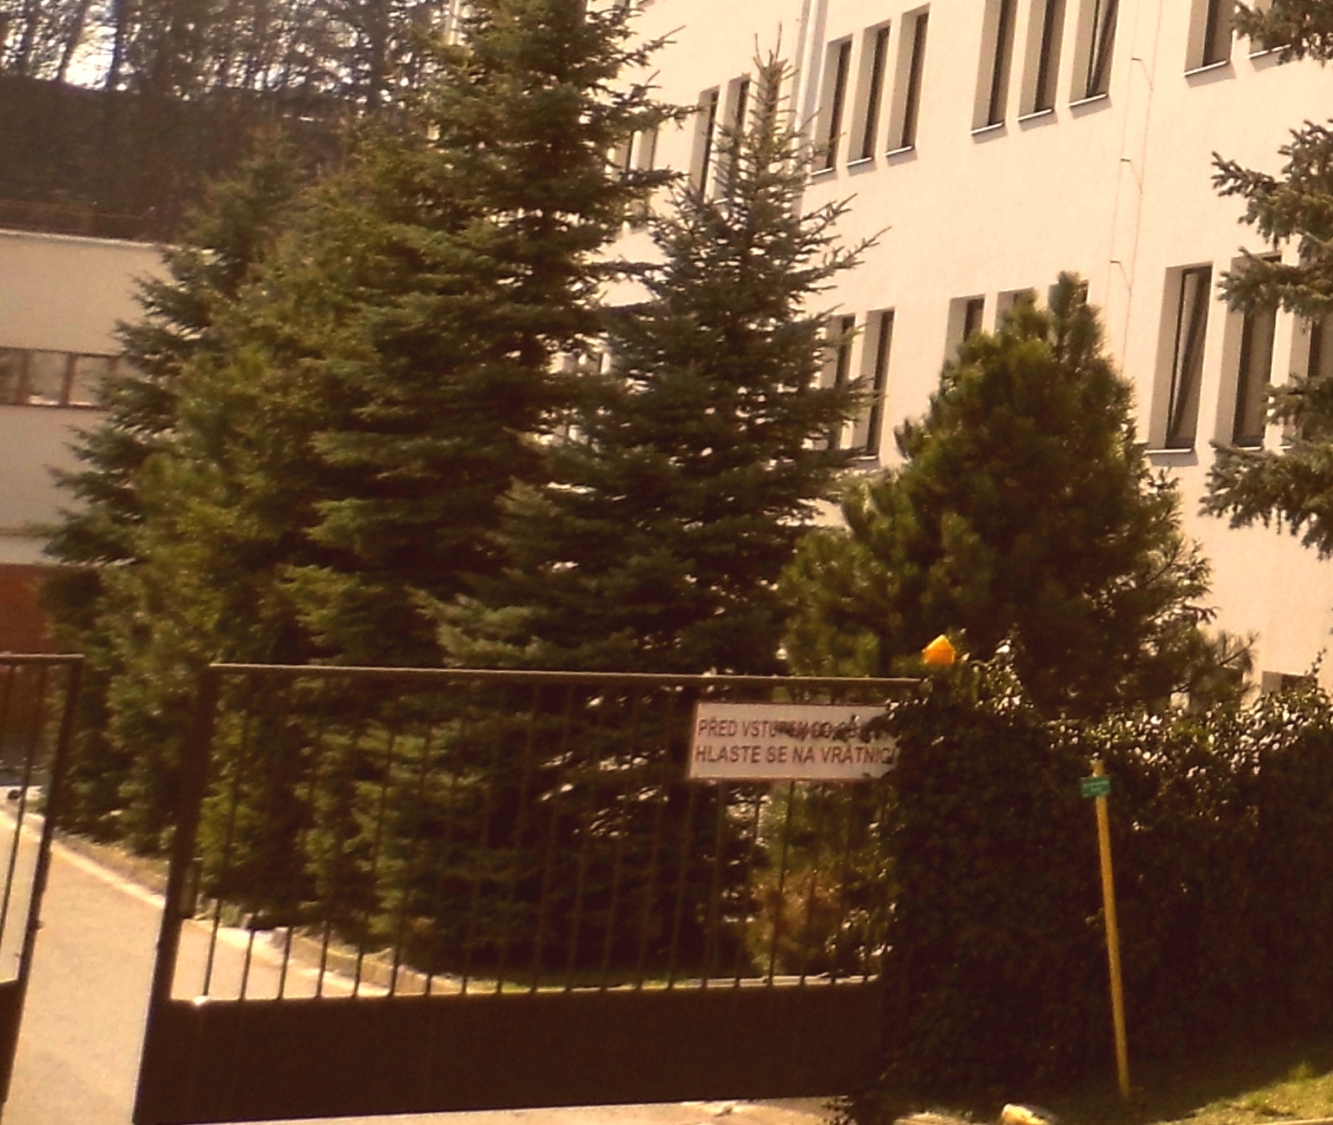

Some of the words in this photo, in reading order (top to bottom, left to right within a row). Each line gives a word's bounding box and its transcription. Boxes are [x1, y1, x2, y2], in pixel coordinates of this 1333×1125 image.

[698, 717, 738, 737] PŘED
[694, 745, 761, 764] HLASTE
[764, 745, 788, 764] SE
[791, 746, 815, 764] NA
